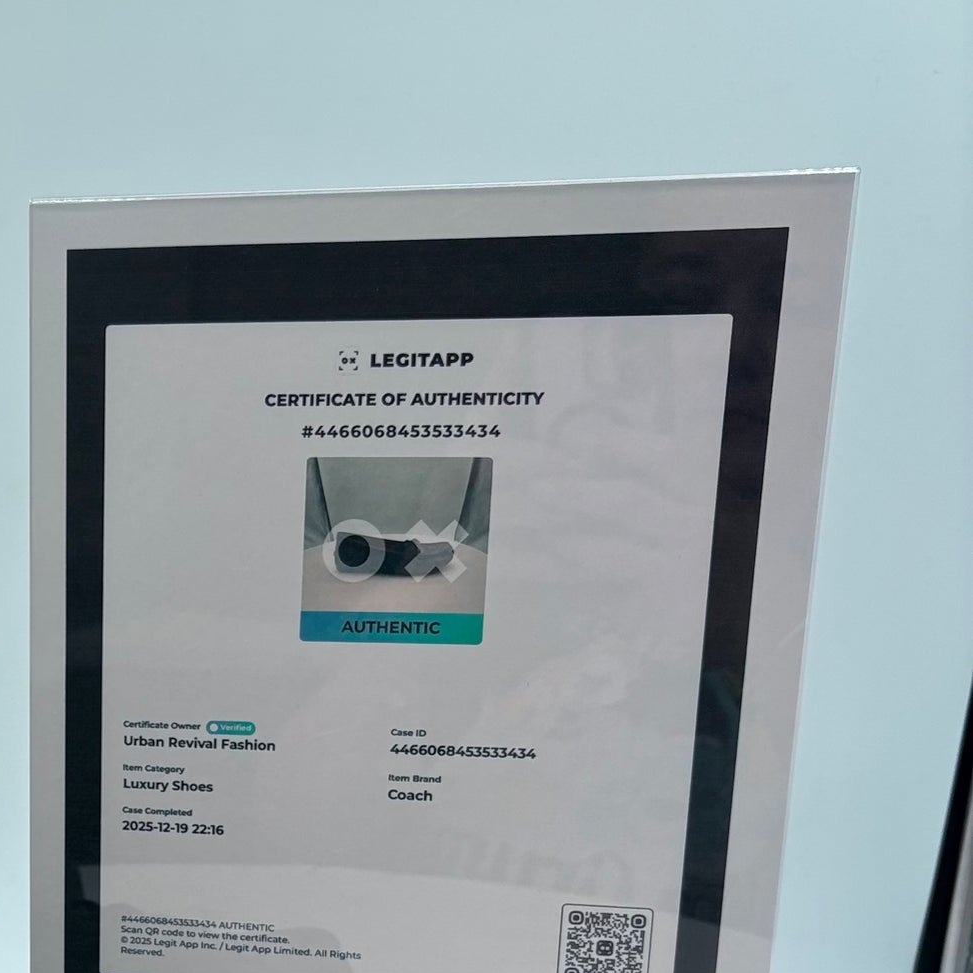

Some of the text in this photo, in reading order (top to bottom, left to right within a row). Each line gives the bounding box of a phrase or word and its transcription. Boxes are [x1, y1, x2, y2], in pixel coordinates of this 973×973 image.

[370, 352, 474, 368] LEGITAPP
[264, 391, 545, 407] CERTIFICATE OF AUTHENTICITY
[301, 425, 501, 439] #4466068453533434
[341, 620, 441, 635] AUTHENTIC
[123, 720, 253, 732] Certificate Owner Verified
[390, 728, 427, 737] Case ID
[123, 735, 276, 751] Urban Revival Fashion
[390, 743, 536, 759] 4466068453533434
[122, 764, 185, 775] Item Category
[123, 778, 214, 793] Luxury Shoes
[388, 774, 442, 783] Item Brand
[388, 789, 433, 801] Coach
[122, 806, 193, 817] Case Completed
[122, 820, 225, 836] 2025-12-19 22:16
[121, 915, 275, 933] #4466068453533434 AUTHENTIC
[120, 925, 290, 944] Scan QR code to view the certificate.
[120, 946, 165, 957] Reserved.
[129, 936, 152, 945] 2025
[153, 938, 177, 948] Legit
[179, 940, 199, 950] App
[200, 941, 217, 950] Inc.
[218, 941, 224, 951] /
[225, 943, 249, 953] Legit
[251, 945, 271, 955] App
[273, 946, 313, 957] Limited.
[314, 949, 327, 957] All
[329, 950, 362, 960] Rights
